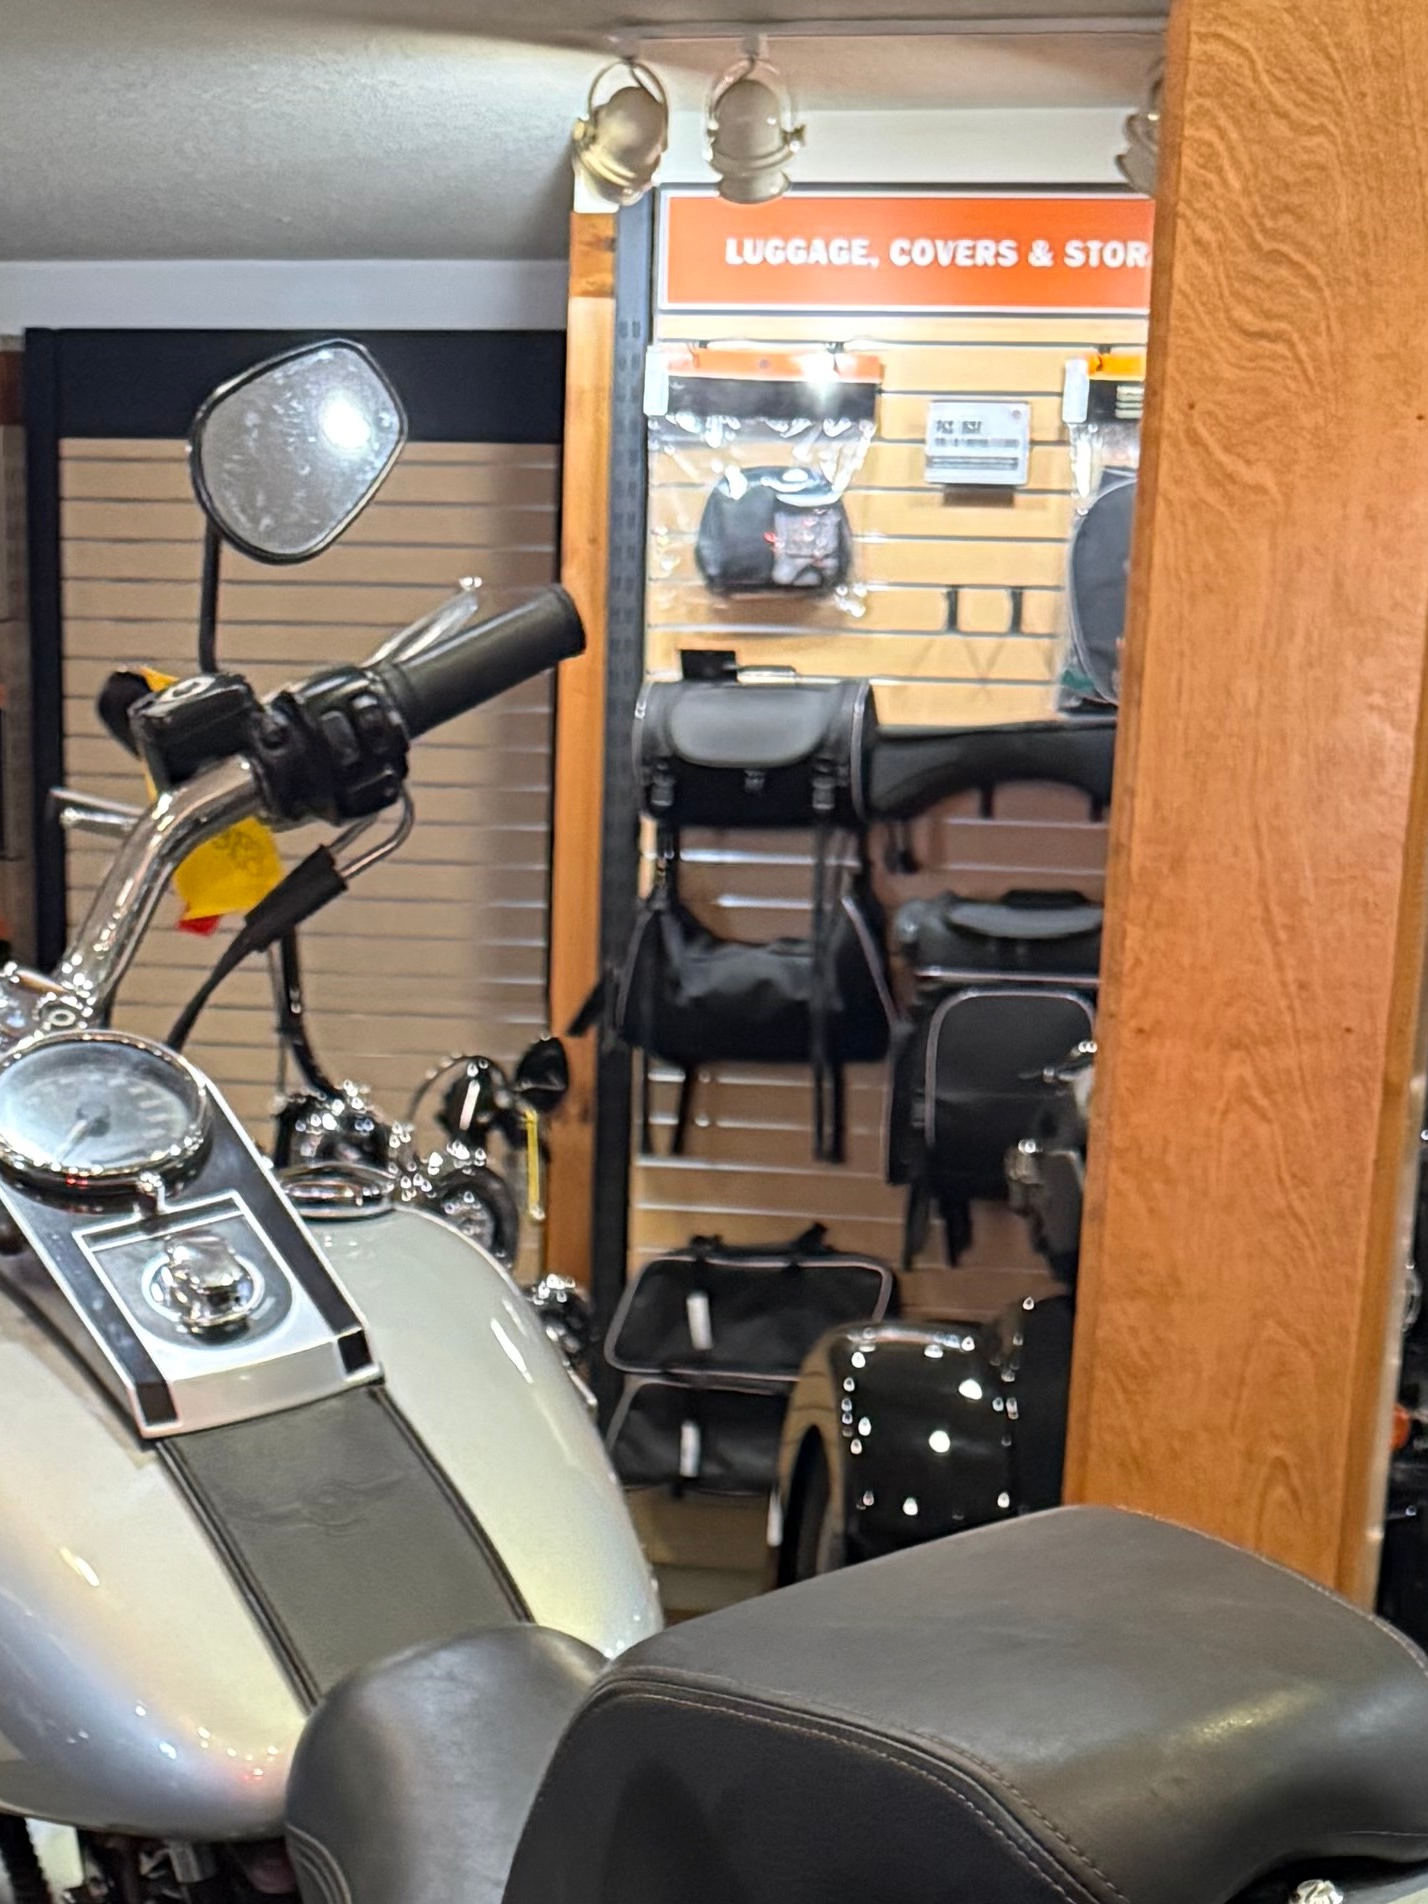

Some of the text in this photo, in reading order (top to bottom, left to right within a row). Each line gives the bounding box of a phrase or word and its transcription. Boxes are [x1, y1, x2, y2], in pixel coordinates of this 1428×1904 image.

[725, 238, 1150, 268] LUGGAGE, COVERS & STOR
